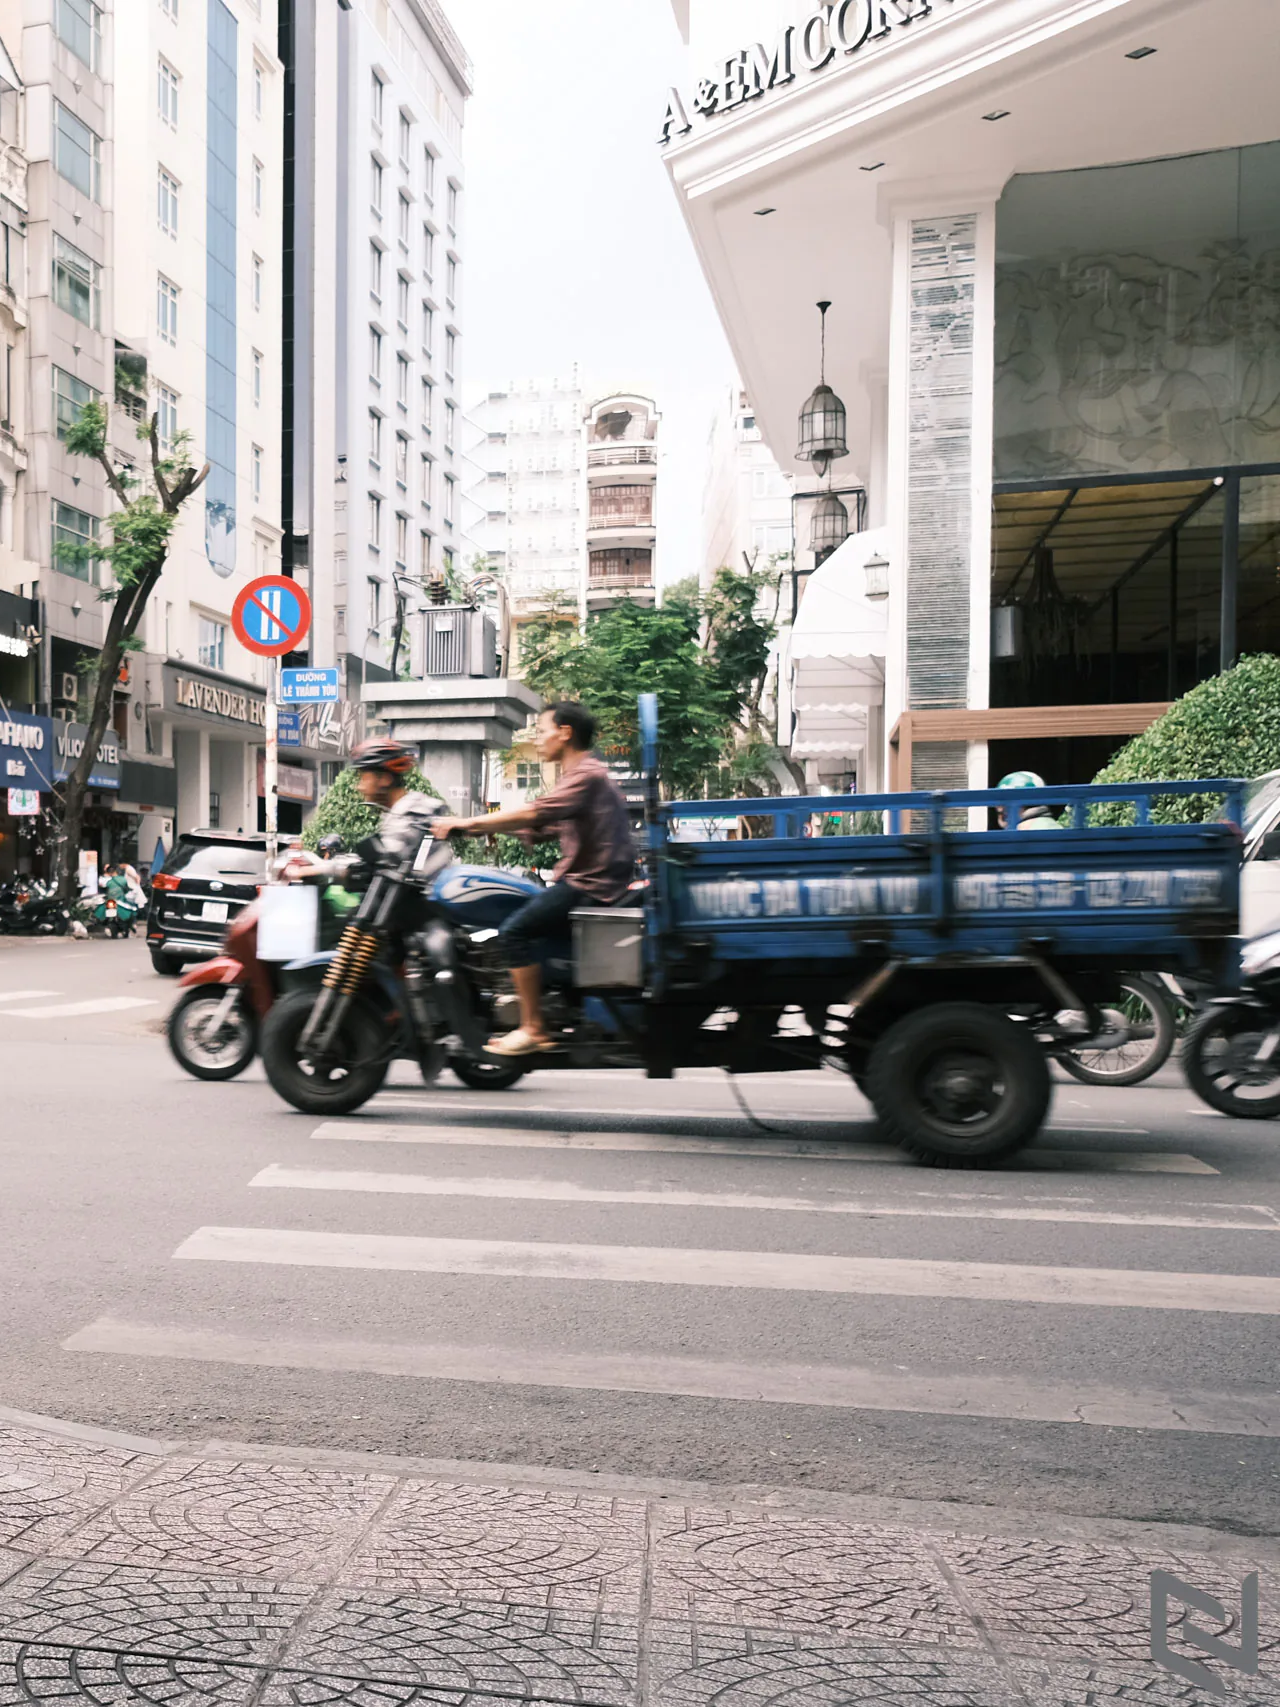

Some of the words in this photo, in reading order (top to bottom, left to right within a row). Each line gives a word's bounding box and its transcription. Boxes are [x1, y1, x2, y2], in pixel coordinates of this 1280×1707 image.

[796, 0, 954, 71] COR
[175, 677, 248, 721] LAVENDER
[95, 743, 120, 765] OTEL
